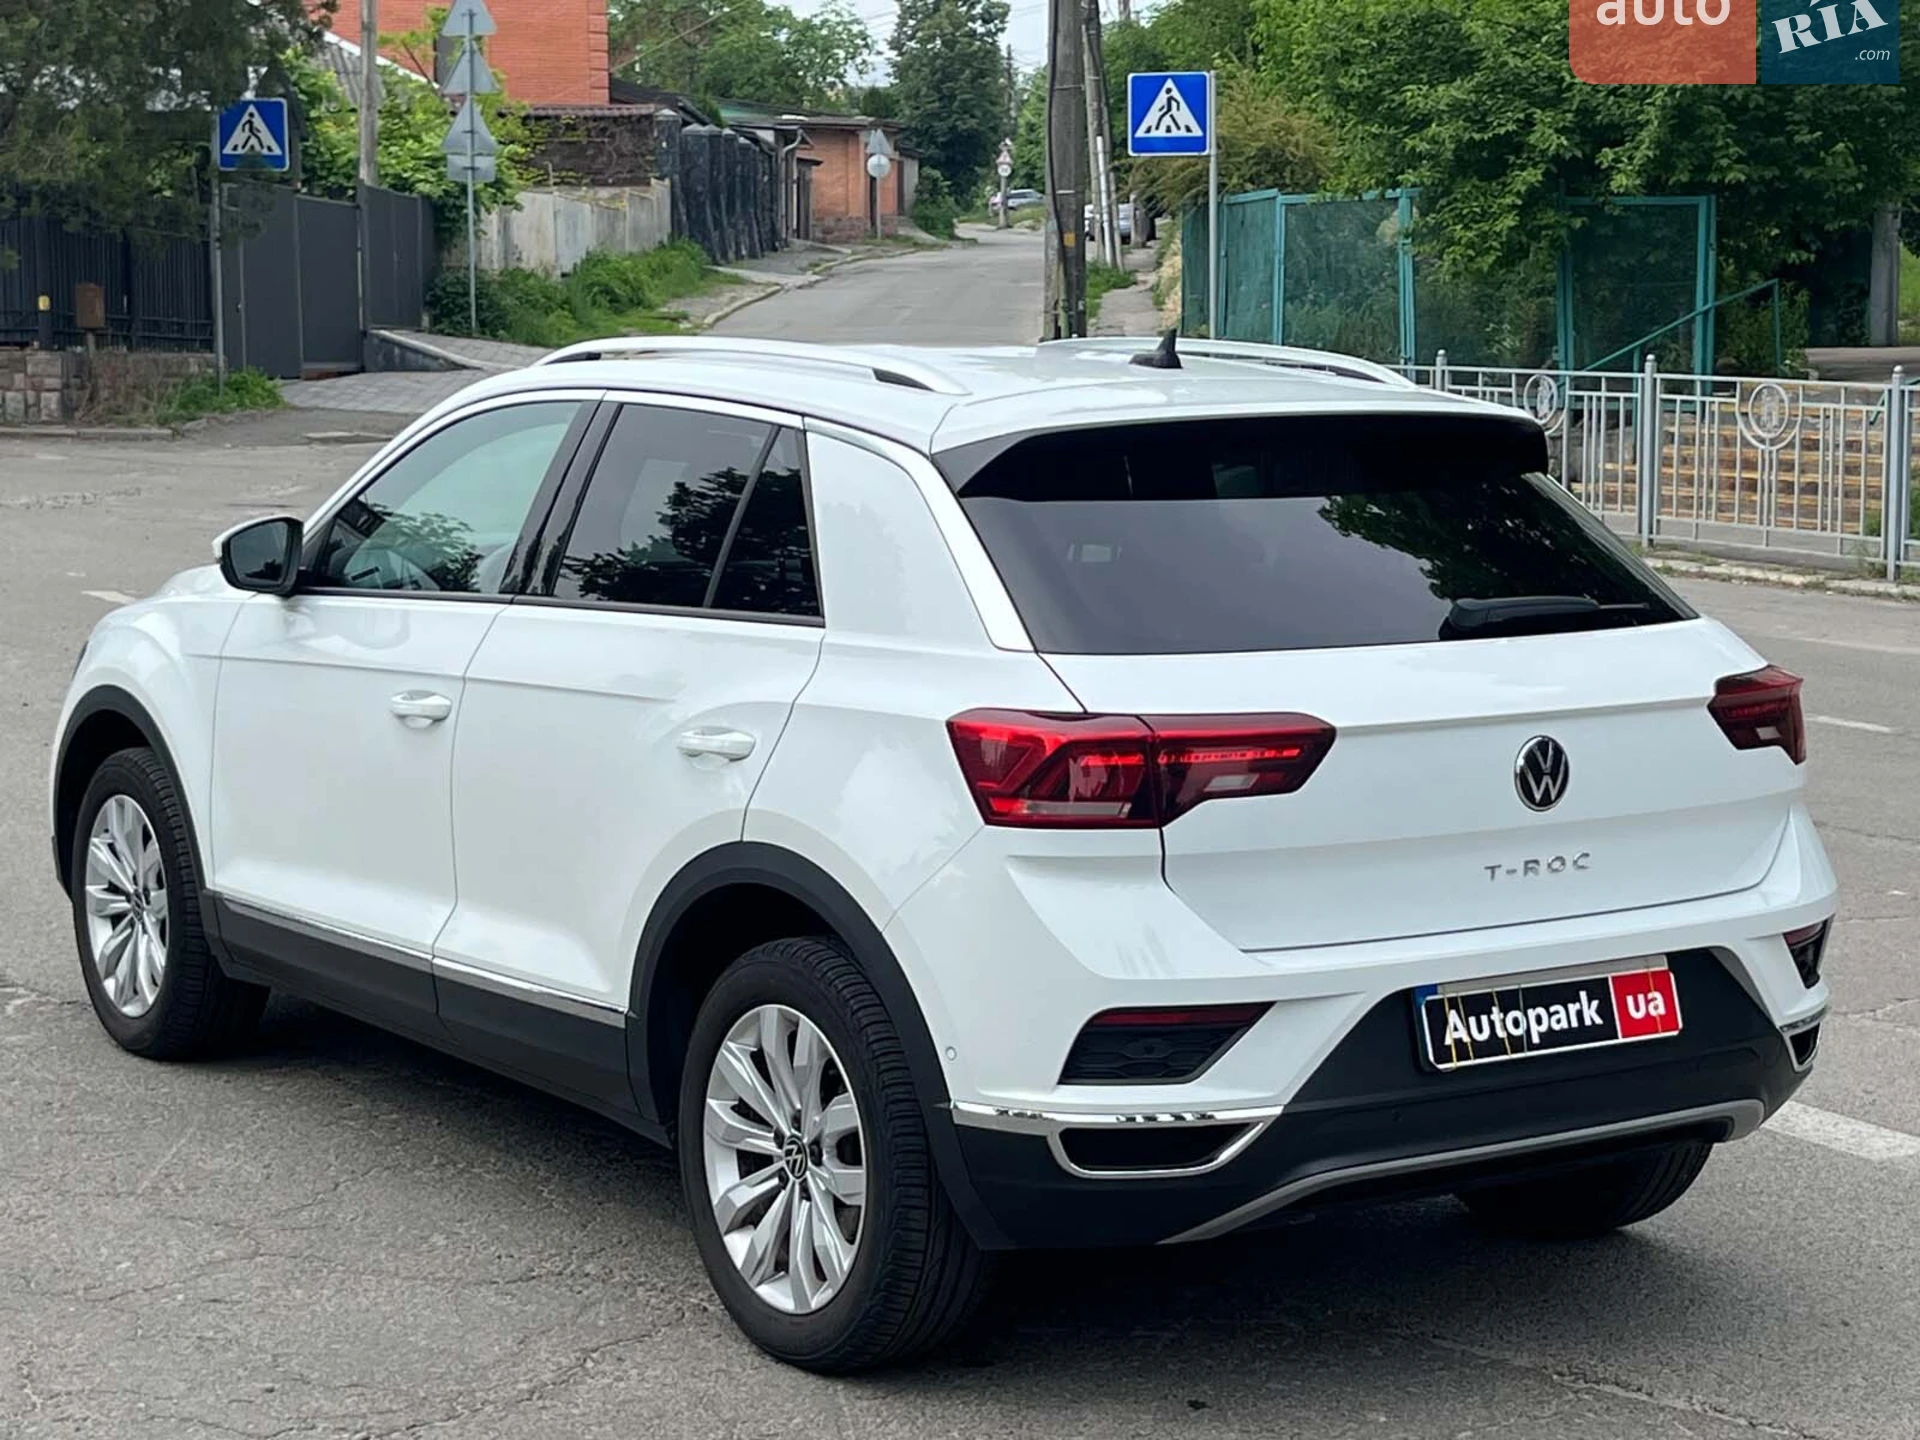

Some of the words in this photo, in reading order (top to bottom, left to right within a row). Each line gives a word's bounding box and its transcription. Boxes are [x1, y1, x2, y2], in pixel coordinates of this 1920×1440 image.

[1484, 852, 1591, 881] T-ROC
[1444, 991, 1604, 1046] Autopark
[1626, 991, 1667, 1020] ua
